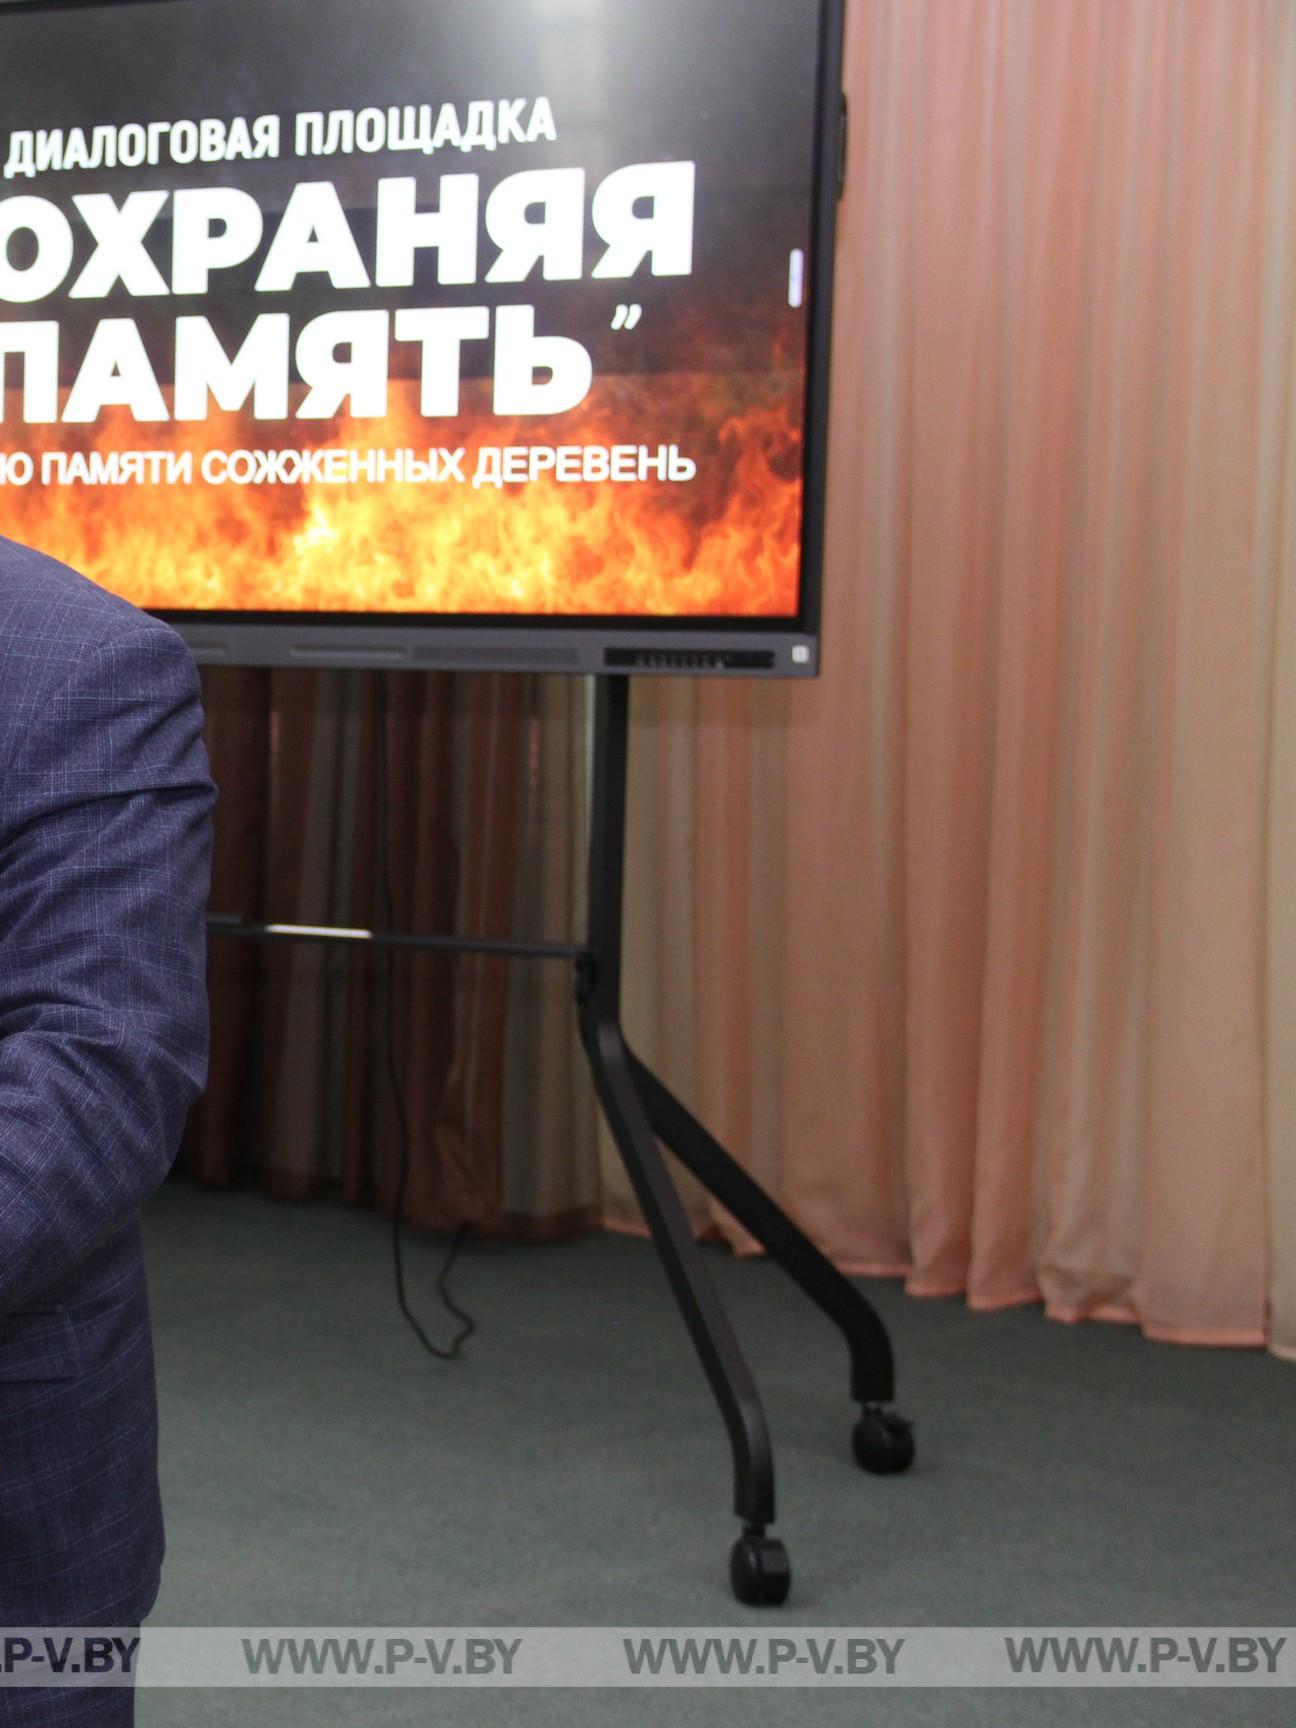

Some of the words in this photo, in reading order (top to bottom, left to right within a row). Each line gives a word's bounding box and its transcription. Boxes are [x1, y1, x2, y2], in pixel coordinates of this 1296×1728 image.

[3, 114, 281, 180] ДИАЛОГОВАЯ
[295, 96, 558, 156] ПЛОЩАДКА
[41, 450, 193, 485] ПАМЯТИ
[201, 447, 466, 485] СОЖЖЕННЫХ
[471, 444, 696, 489] ДЕРЕВЕНЬ
